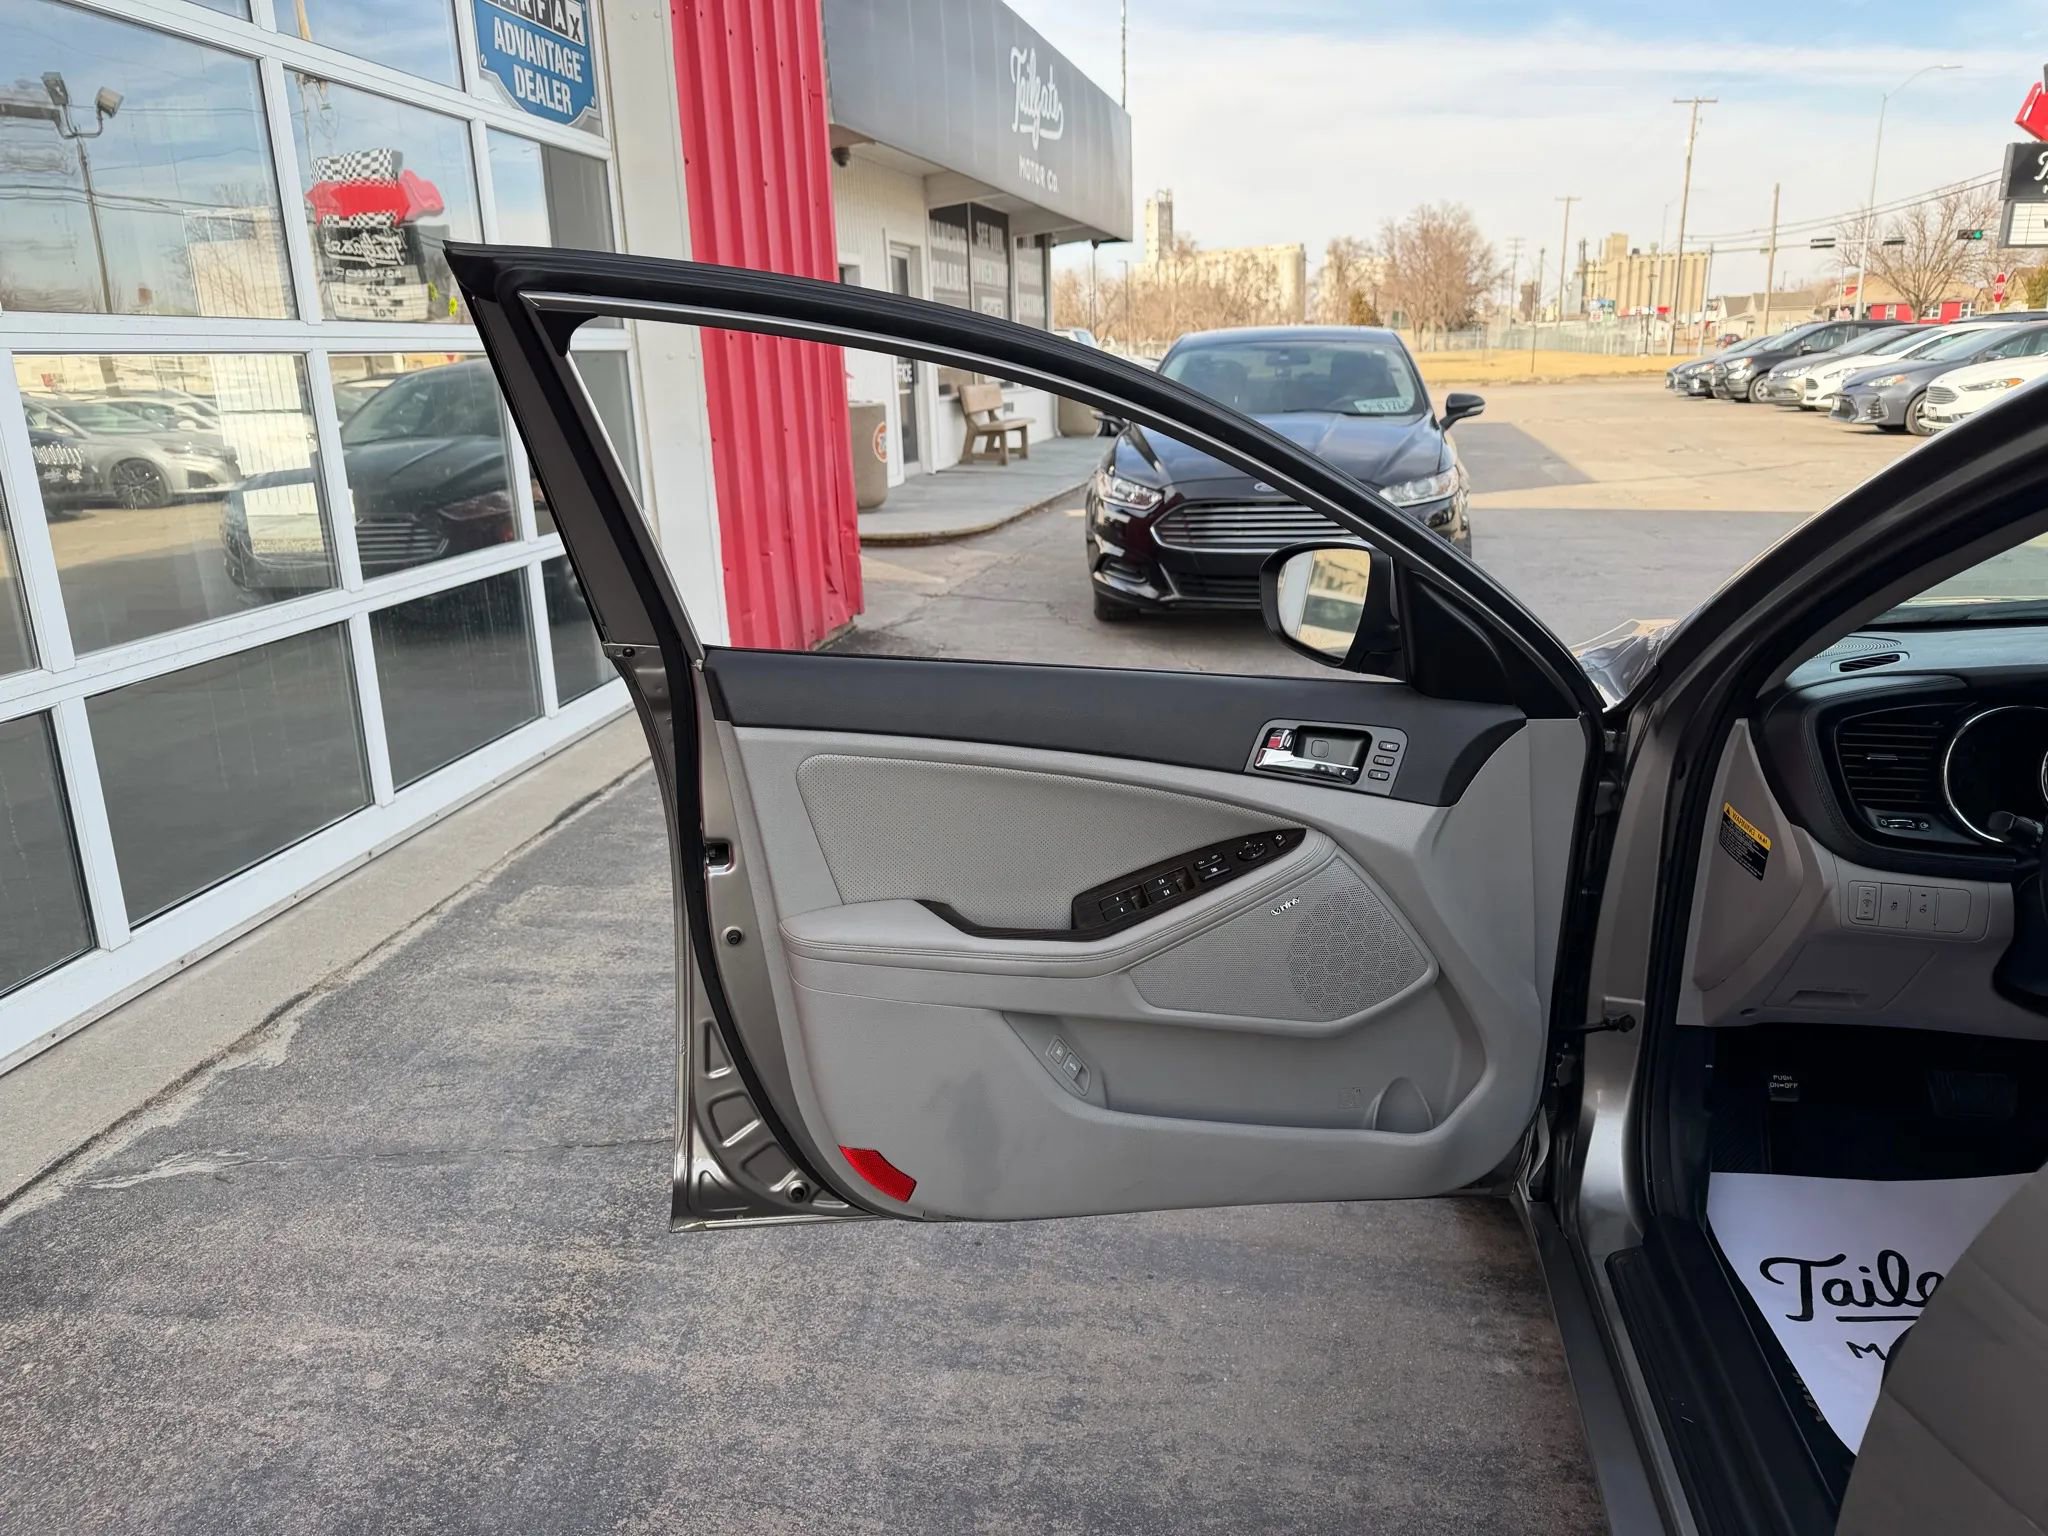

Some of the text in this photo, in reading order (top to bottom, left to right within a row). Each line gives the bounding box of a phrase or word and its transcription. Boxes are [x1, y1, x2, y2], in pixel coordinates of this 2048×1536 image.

[494, 16, 583, 83] ADVANTAGE
[513, 63, 573, 115] DEALER
[1018, 154, 1046, 189] MOTOR
[1732, 811, 1756, 836] WARNING
